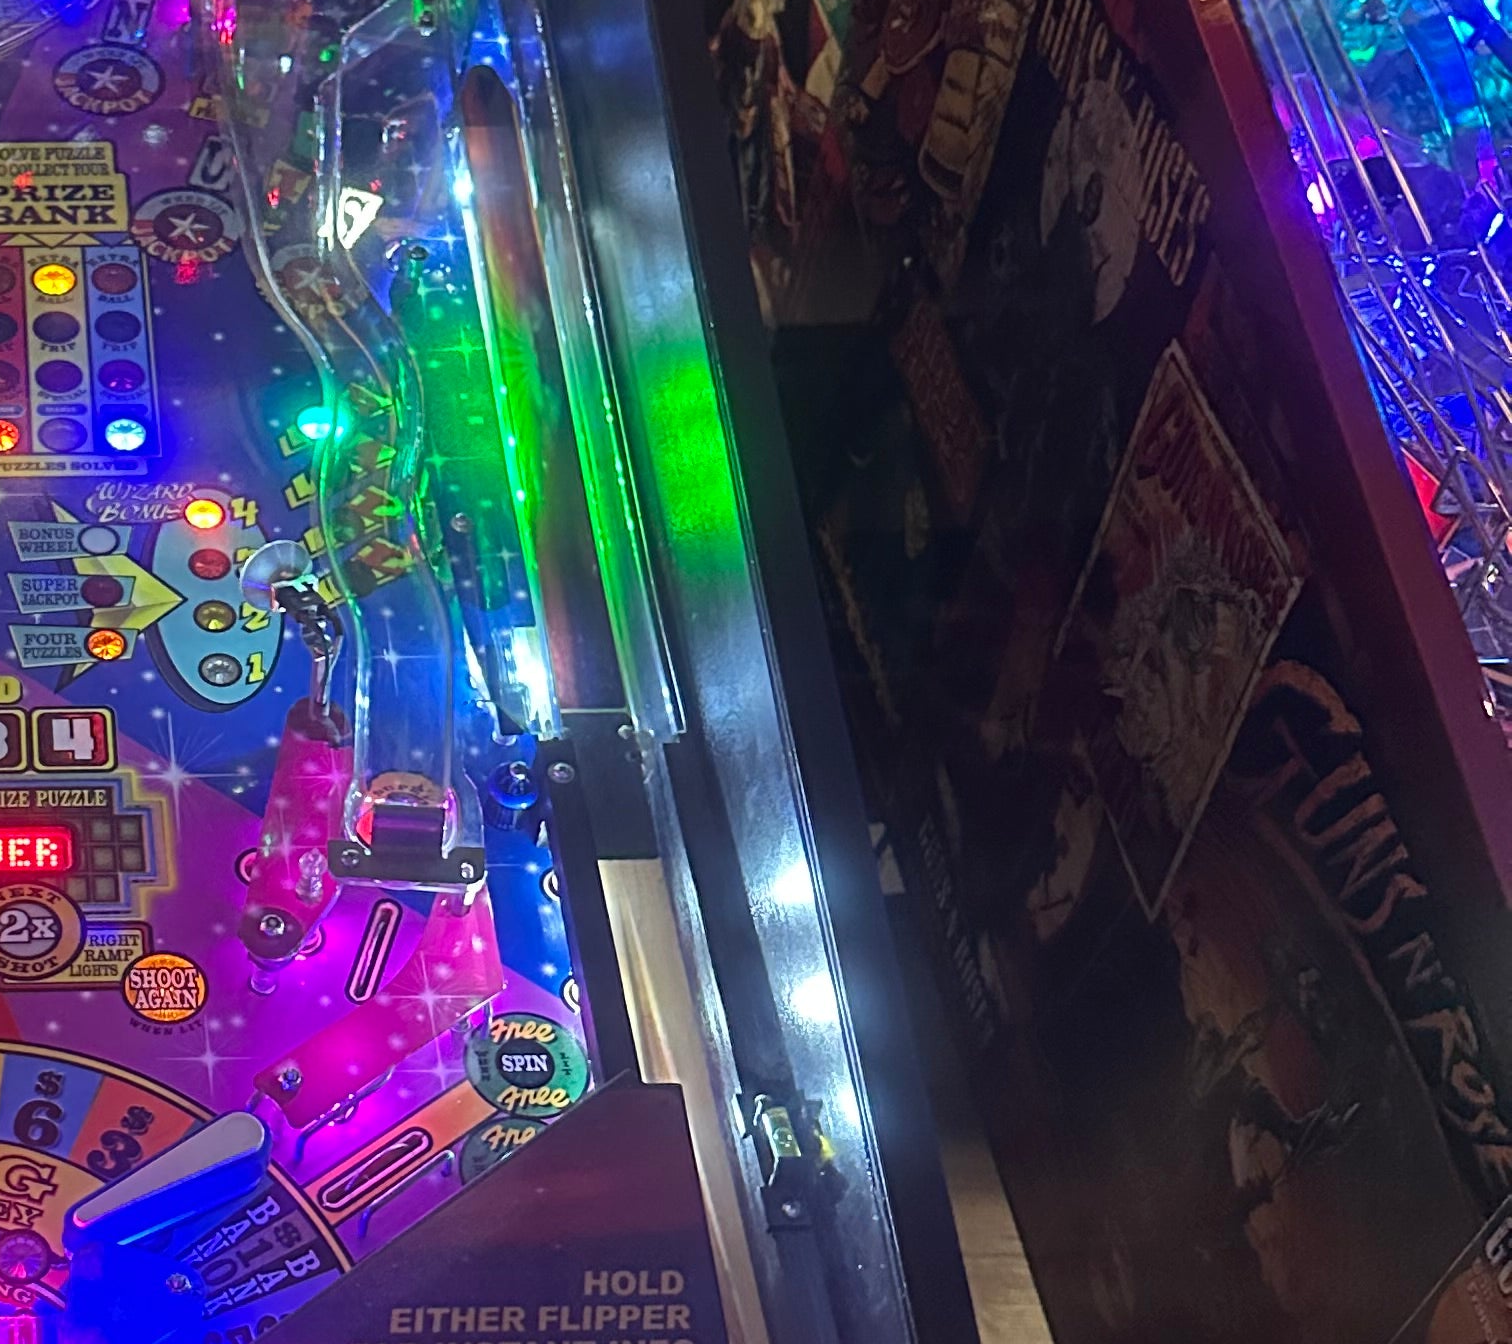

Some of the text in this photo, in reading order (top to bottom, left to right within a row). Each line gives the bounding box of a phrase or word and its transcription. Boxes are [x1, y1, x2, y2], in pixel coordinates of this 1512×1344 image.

[55, 73, 152, 115] JACKPOT
[45, 147, 106, 161] PUZZLE
[9, 163, 71, 177] COLLECT
[72, 163, 109, 176] YOUR
[40, 342, 78, 352] TRIP
[94, 481, 196, 502] WIZARD
[98, 502, 183, 523] BONUS
[229, 496, 259, 527] 4
[17, 527, 75, 541] BONUS
[19, 540, 78, 553] WHEEL
[20, 578, 79, 593] SUPER
[21, 593, 81, 606] JACKPOT
[238, 601, 272, 632] 2
[24, 632, 78, 646] FOUR
[22, 646, 82, 660] PUZZLES
[245, 652, 267, 684] 1
[51, 717, 95, 763] 4
[35, 789, 107, 808] PUZZLE
[1242, 658, 1429, 937] GUNS
[88, 934, 139, 948] RIGHT
[86, 948, 134, 962] RAMP
[69, 962, 120, 977] LIGHTS
[130, 967, 200, 992] SHOOT
[133, 989, 199, 1011] AGAIN
[129, 1017, 175, 1035] WHEN
[490, 1017, 557, 1043] Free
[501, 1054, 549, 1073] SPIN
[496, 1084, 571, 1112] Free
[12, 1069, 66, 1149] $6
[202, 1248, 321, 1320] BANK
[584, 1270, 686, 1298] HOLD
[389, 1303, 692, 1335] EITHER FLIPPER
